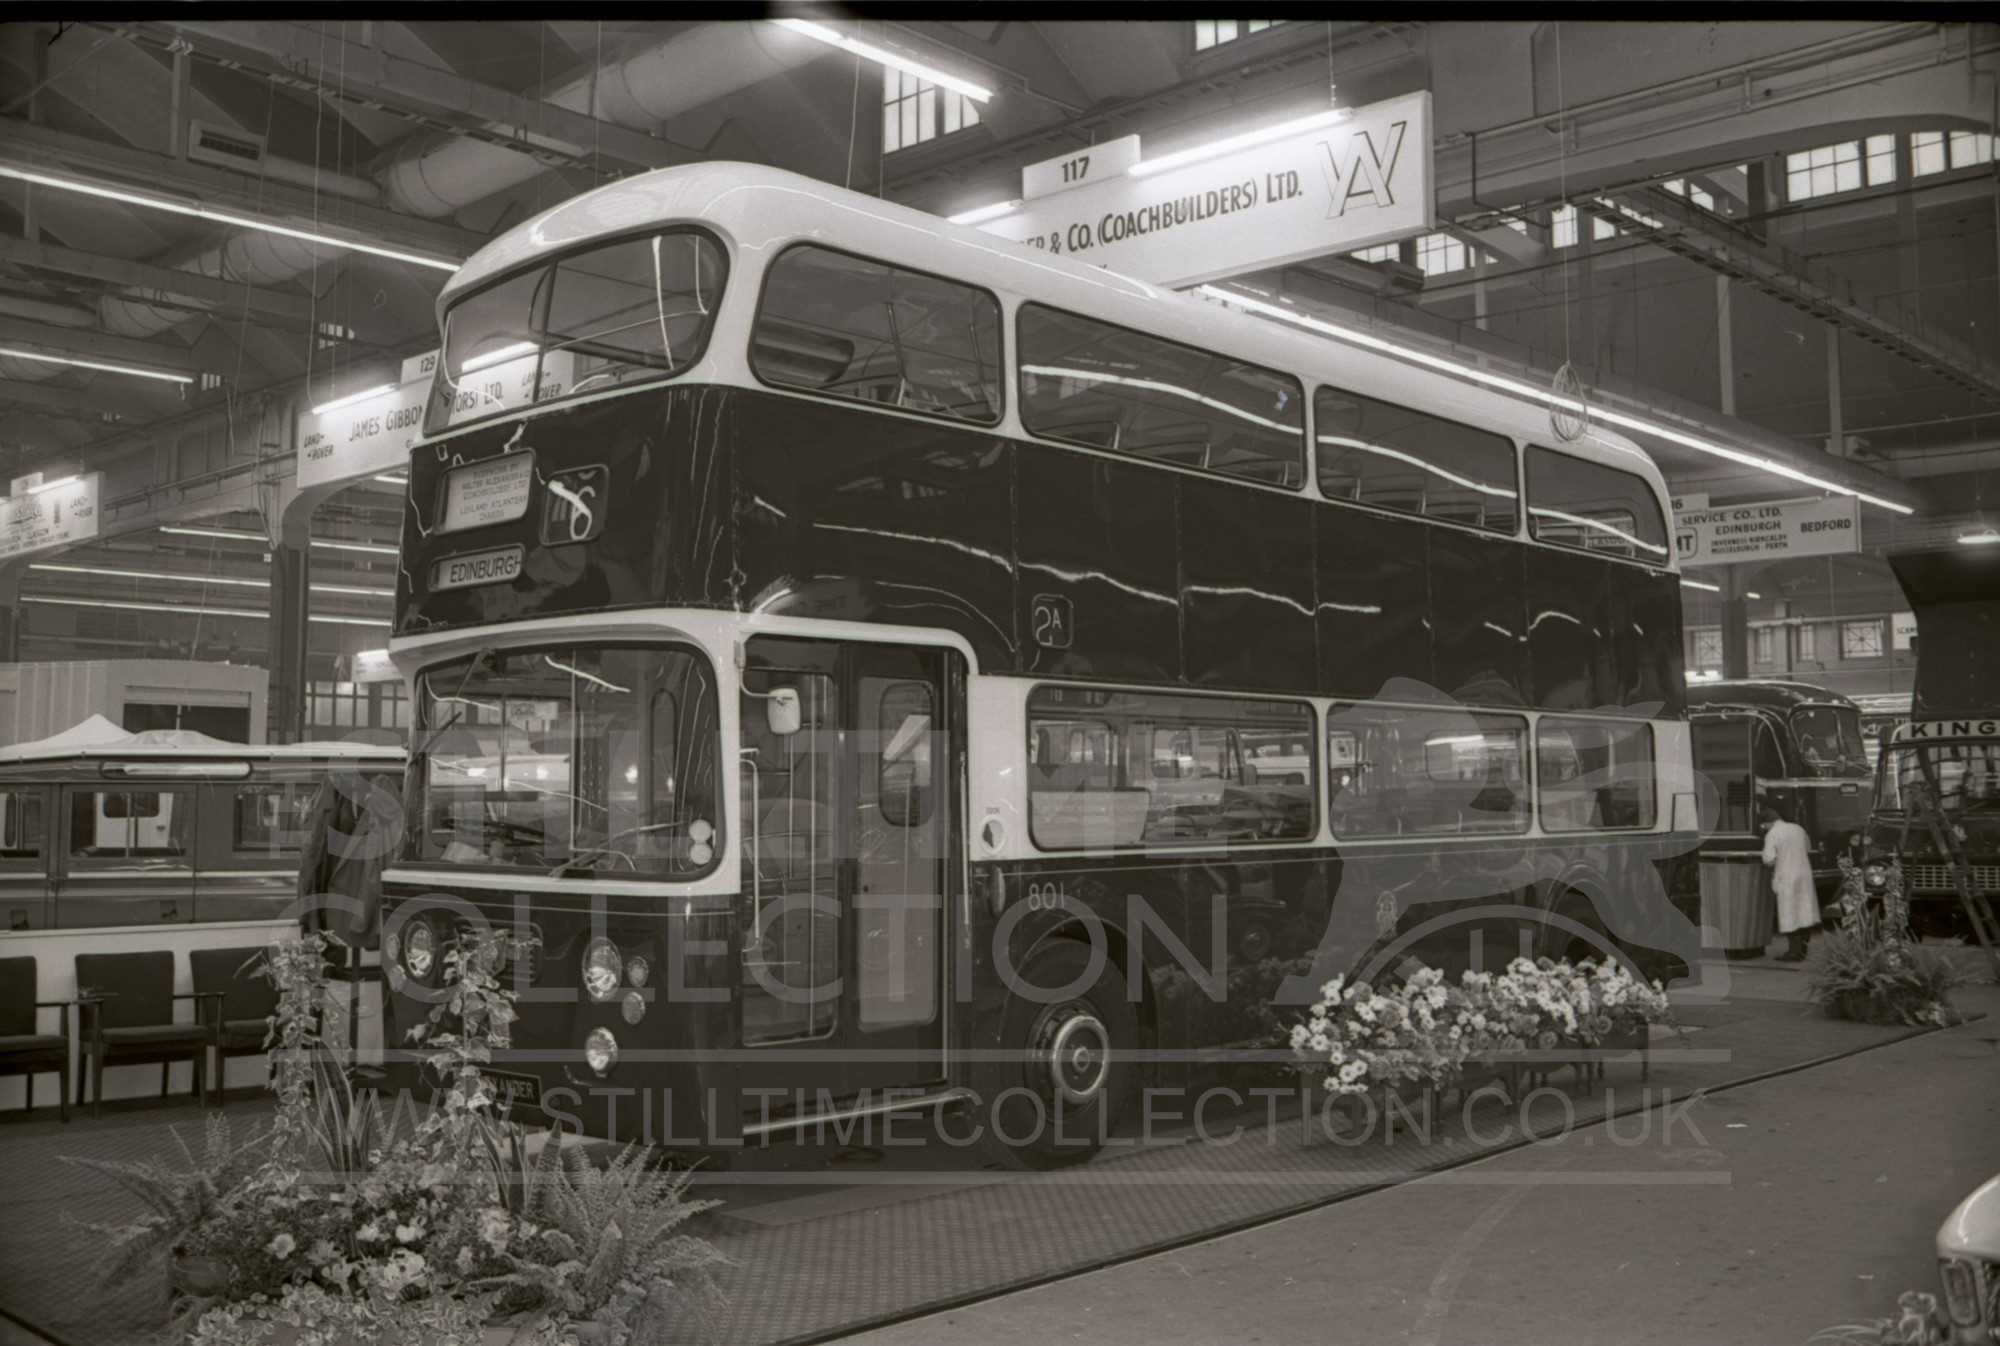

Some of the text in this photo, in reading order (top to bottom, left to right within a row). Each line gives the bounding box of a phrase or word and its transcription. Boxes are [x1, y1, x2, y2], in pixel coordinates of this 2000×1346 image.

[1061, 156, 1090, 183] 117
[1049, 231, 1062, 254] &
[1067, 223, 1094, 252] CO.
[1098, 180, 1257, 247] (COACHBUILDERS)
[1265, 169, 1303, 205] LTD.
[349, 415, 380, 442] JAMES
[1682, 511, 1727, 526] SERVICE
[1759, 506, 1783, 519] LTD.
[1715, 518, 1852, 535] EDINBURGH BEDFORD
[450, 555, 521, 583] EDINBURGH
[1035, 606, 1063, 647] 2A
[1911, 721, 1997, 738] KING
[1028, 881, 1065, 911] 801
